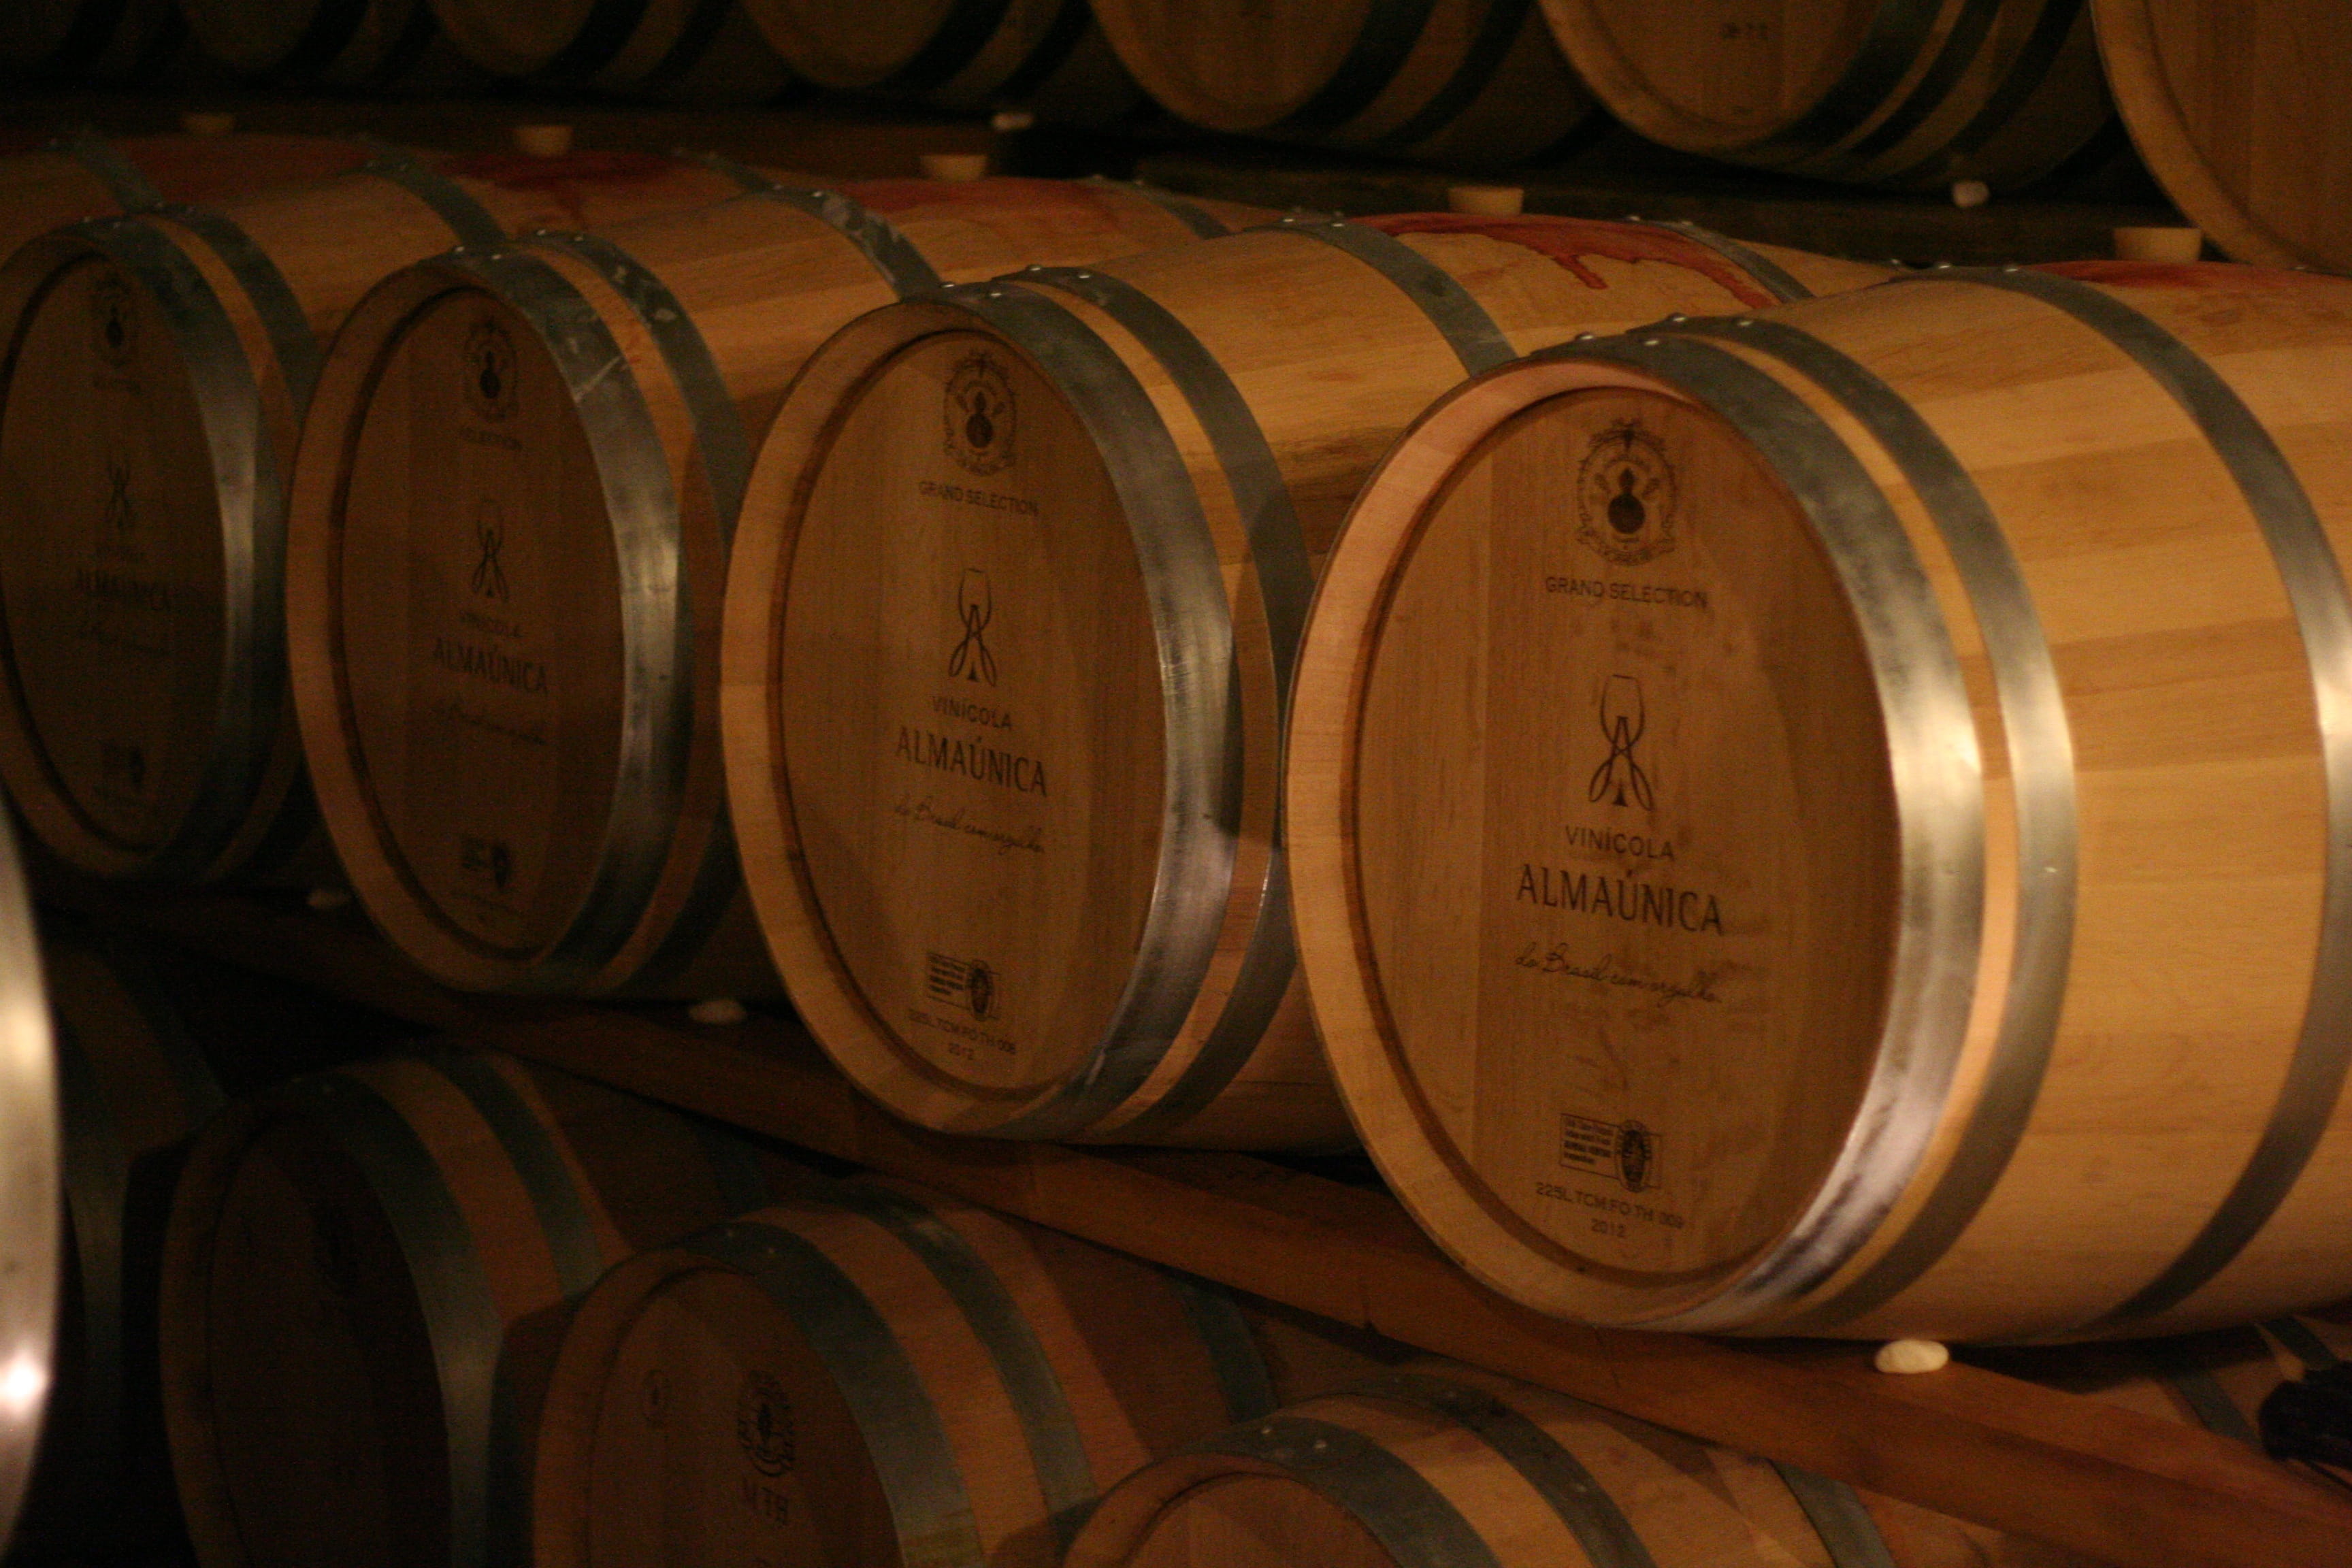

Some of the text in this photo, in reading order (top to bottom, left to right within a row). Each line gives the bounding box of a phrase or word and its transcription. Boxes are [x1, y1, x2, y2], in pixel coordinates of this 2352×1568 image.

[919, 480, 1039, 517] GRAND SELECTION
[1546, 576, 1708, 608] GRAND SELECTION
[895, 725, 1047, 798] ALMAÚNICA
[1516, 863, 1725, 936] ALMAÚNICA
